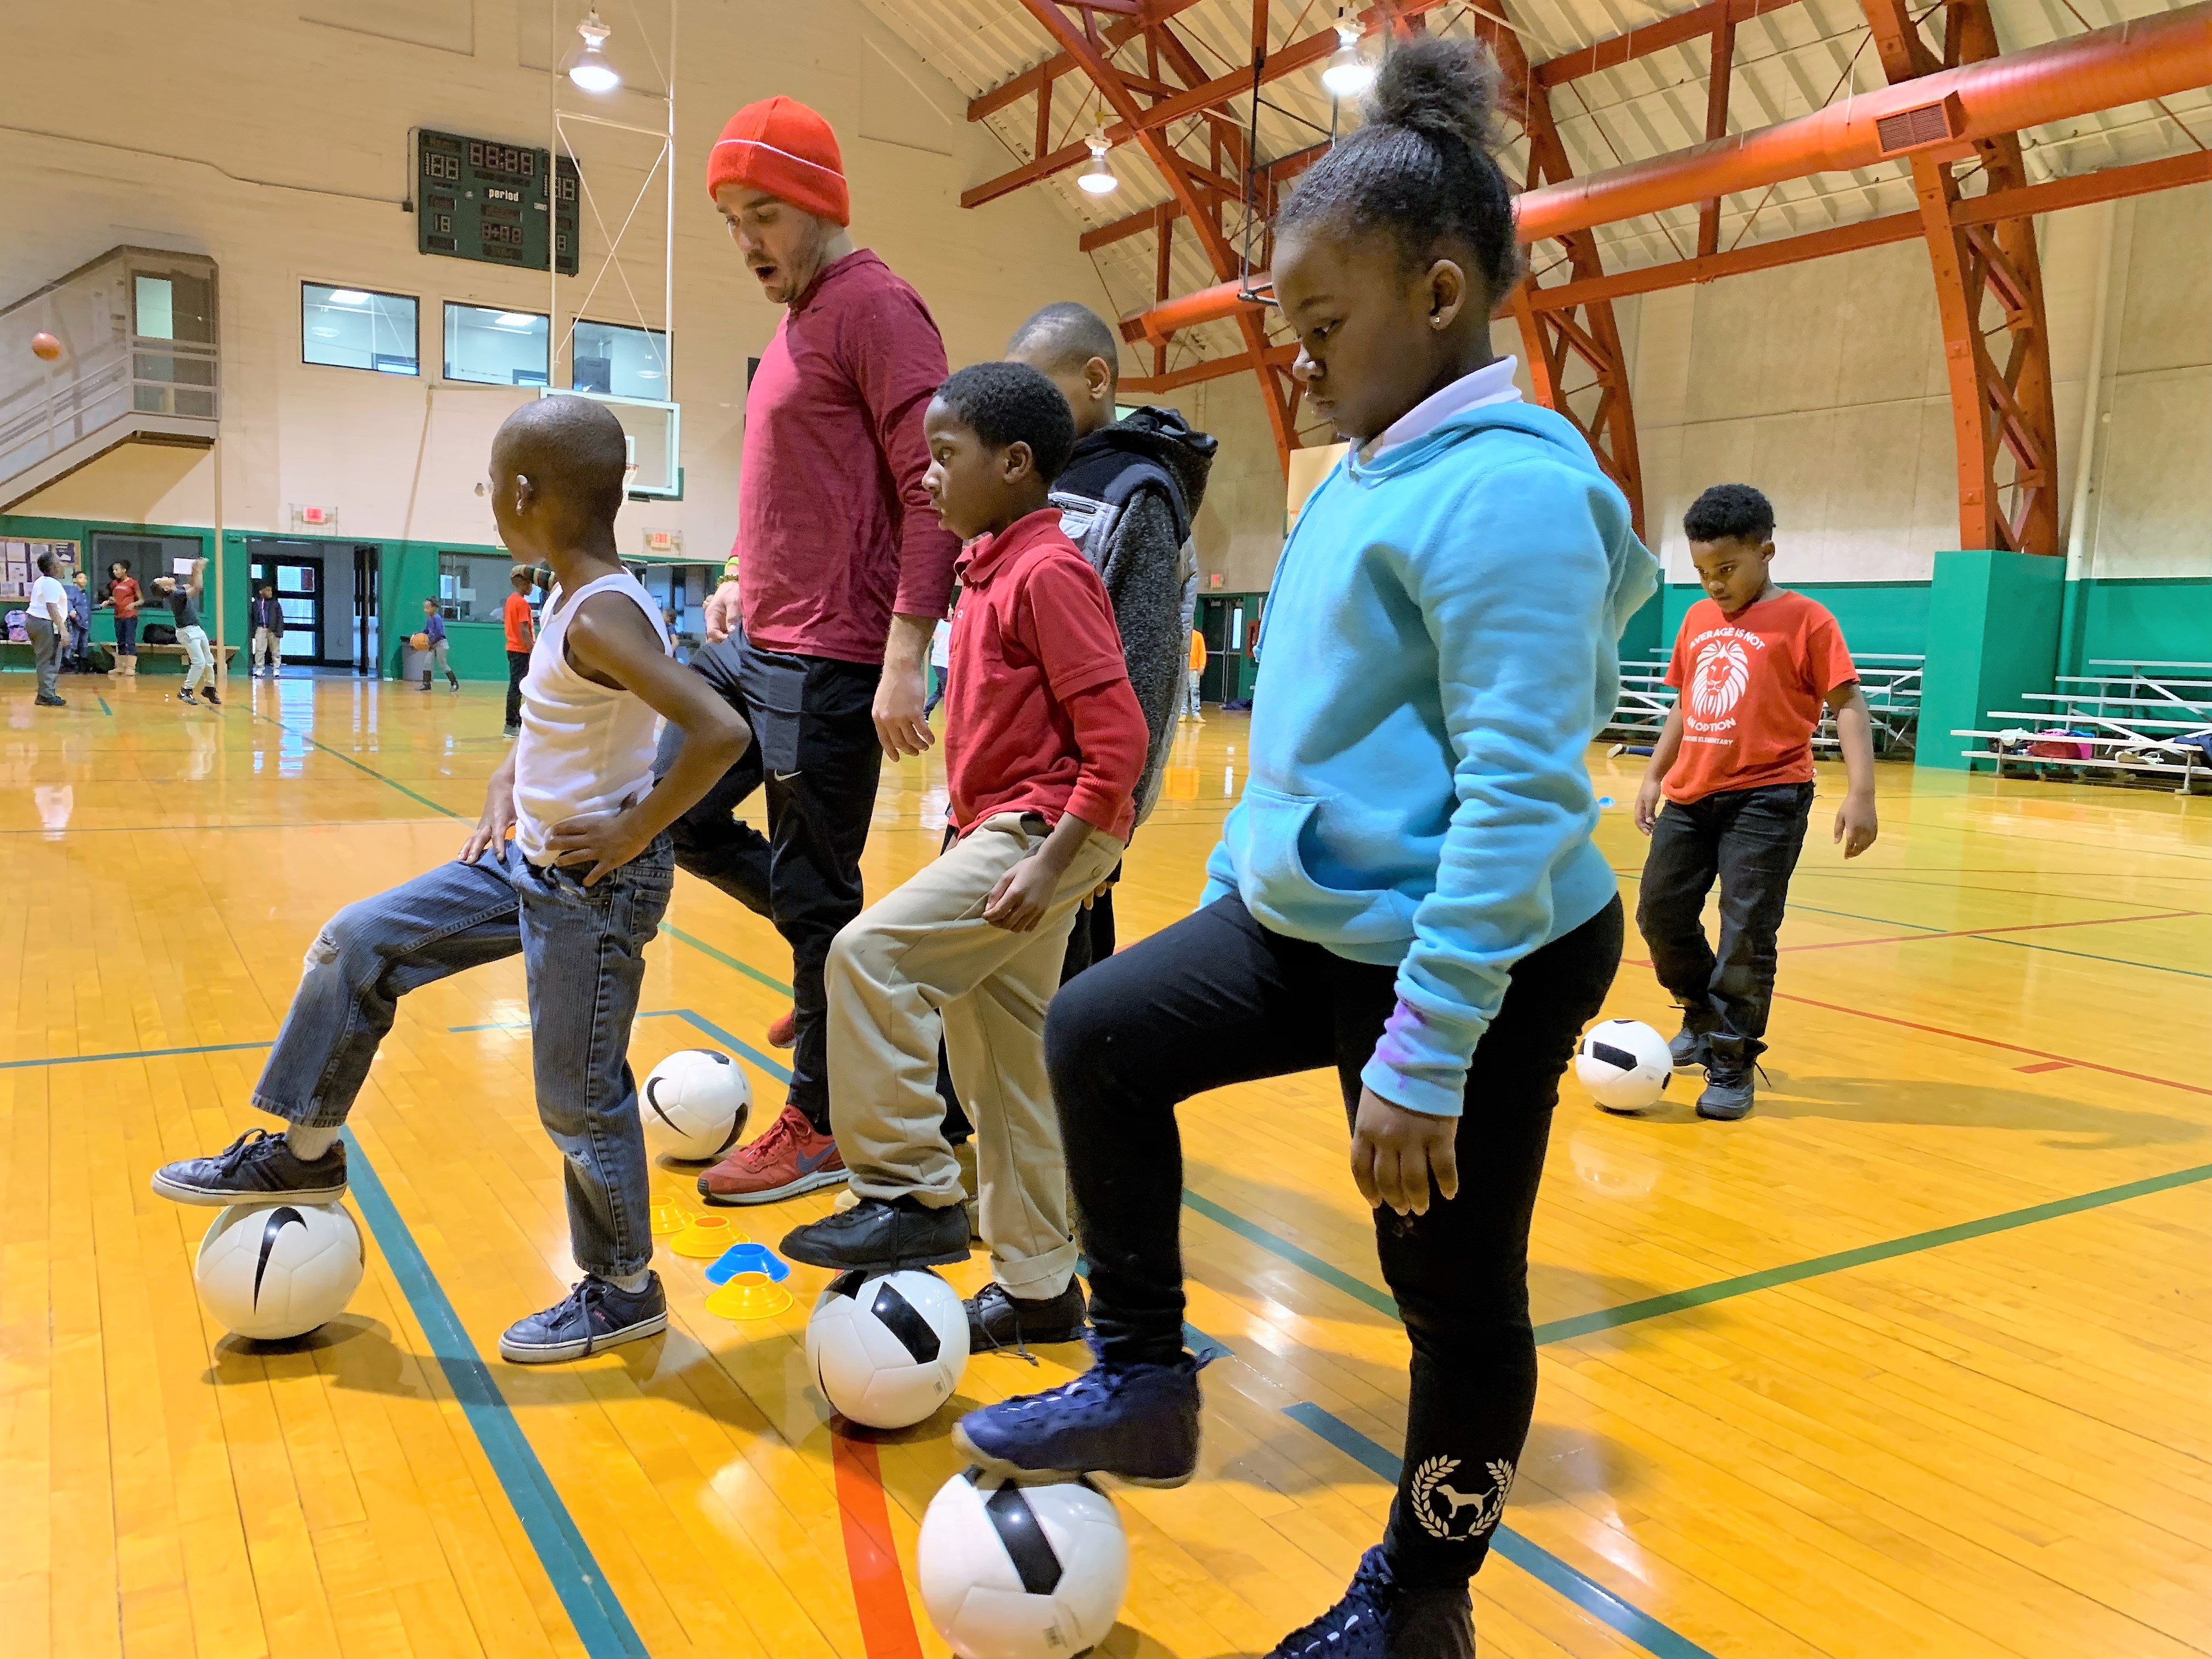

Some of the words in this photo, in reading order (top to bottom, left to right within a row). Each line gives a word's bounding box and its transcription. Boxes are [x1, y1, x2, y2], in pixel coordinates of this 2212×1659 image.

[489, 189, 519, 201] period
[1690, 627, 1735, 650] AVERAGE
[1734, 628, 1745, 638] IS
[1743, 631, 1765, 650] NOT
[1695, 716, 1736, 732] OPTION
